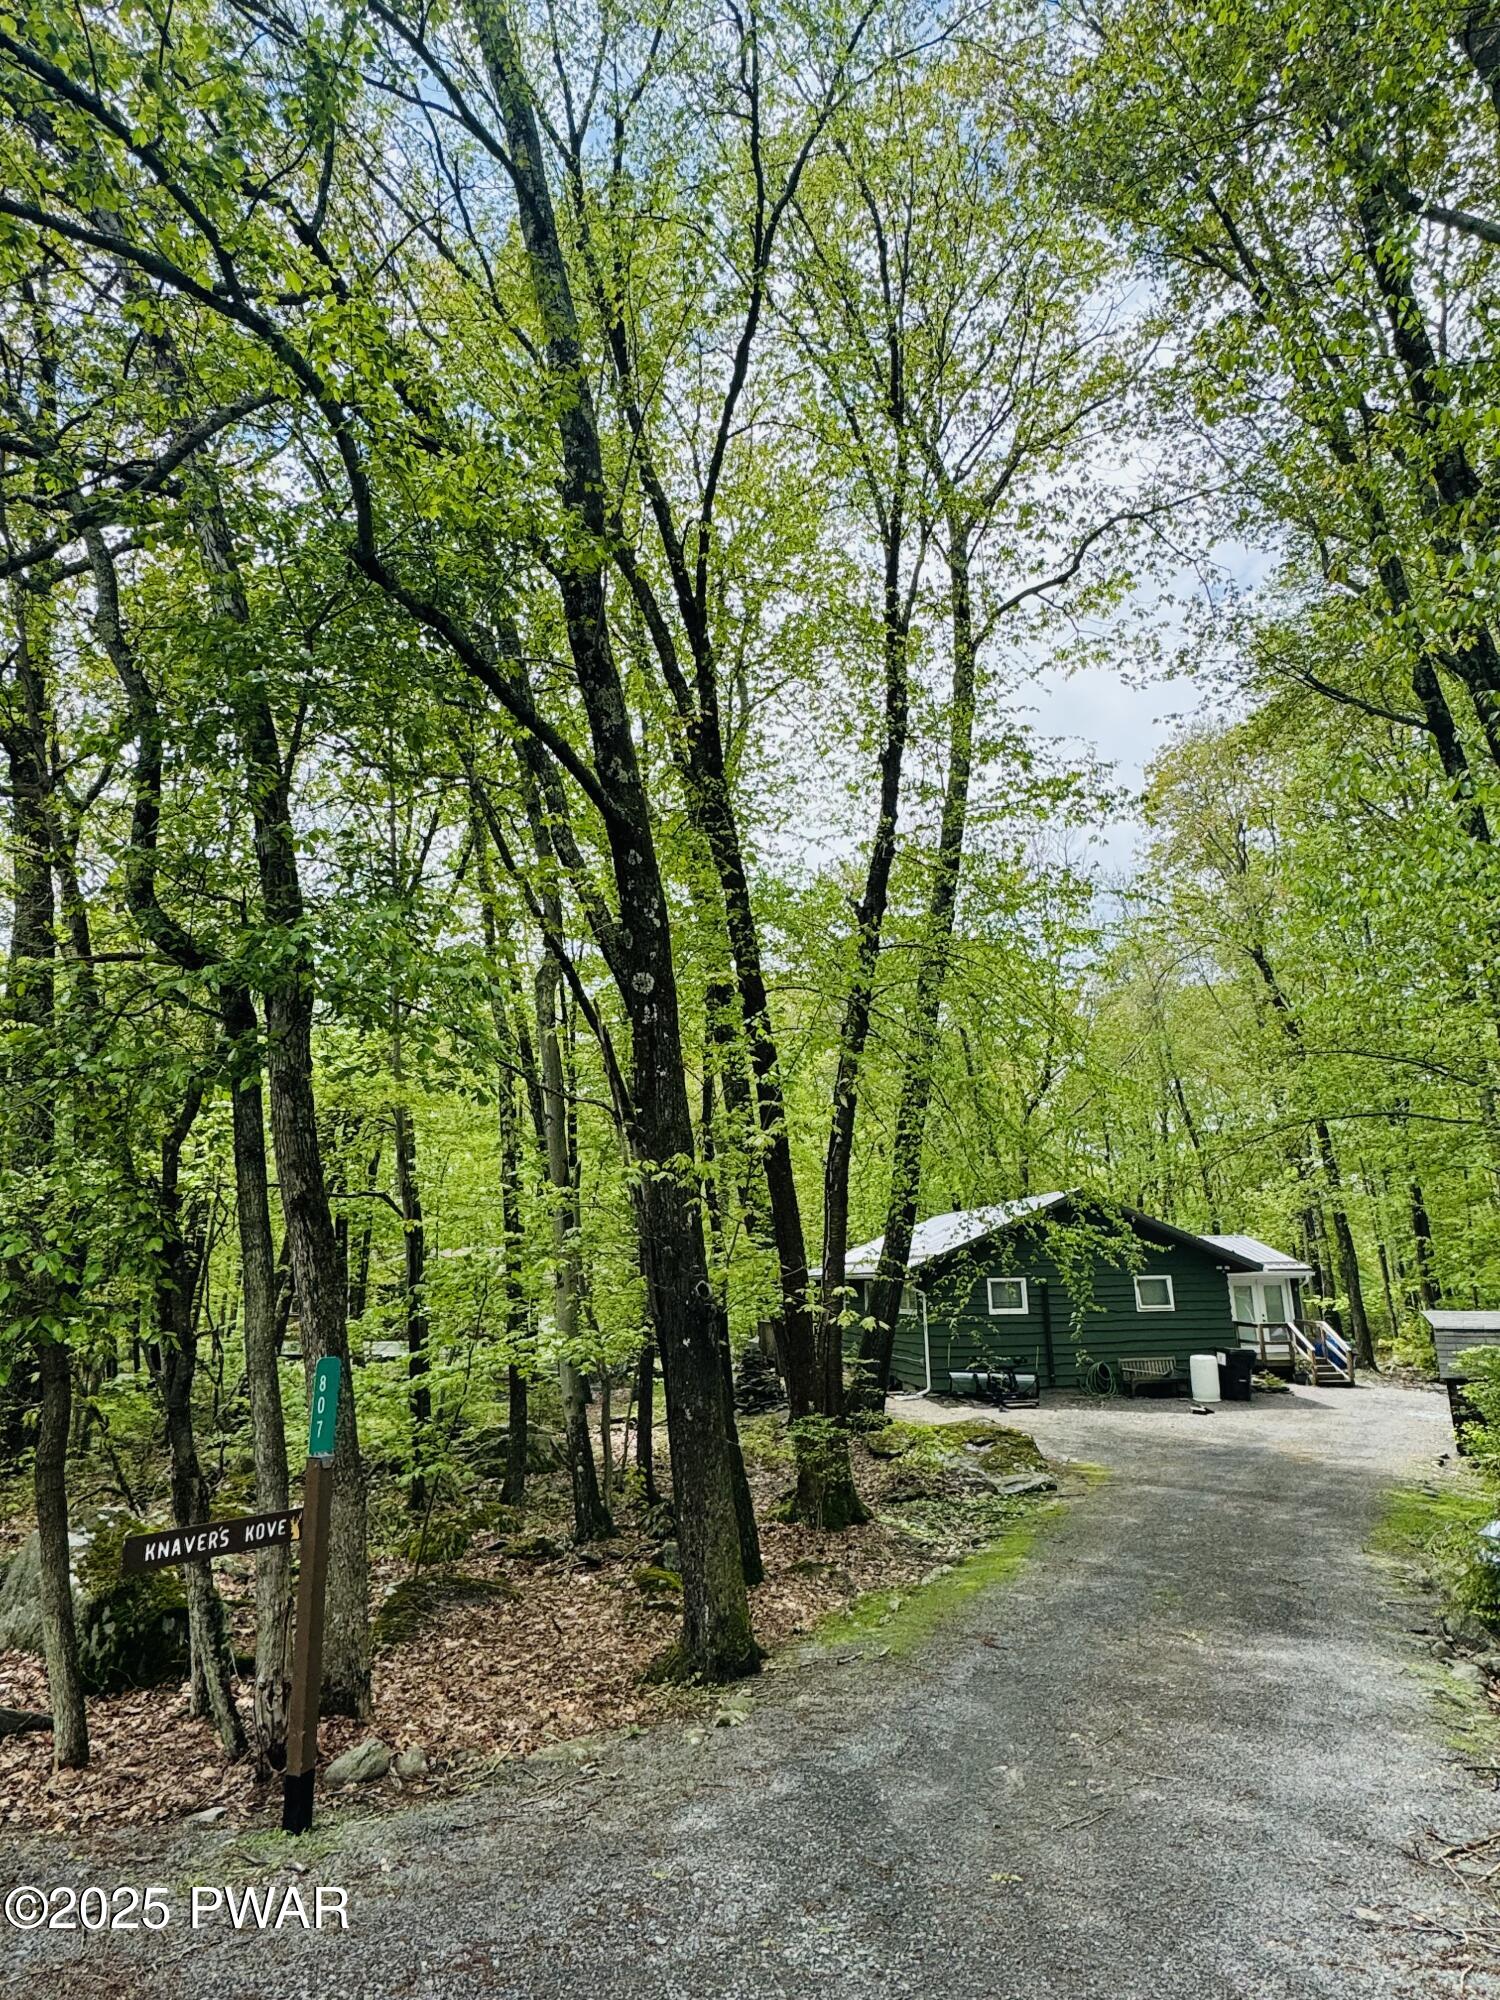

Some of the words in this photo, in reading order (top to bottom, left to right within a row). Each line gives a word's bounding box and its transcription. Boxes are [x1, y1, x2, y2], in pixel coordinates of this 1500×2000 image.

[316, 1374, 327, 1439] 807
[144, 1526, 230, 1562] KNAVER'S
[244, 1518, 287, 1543] KOVE
